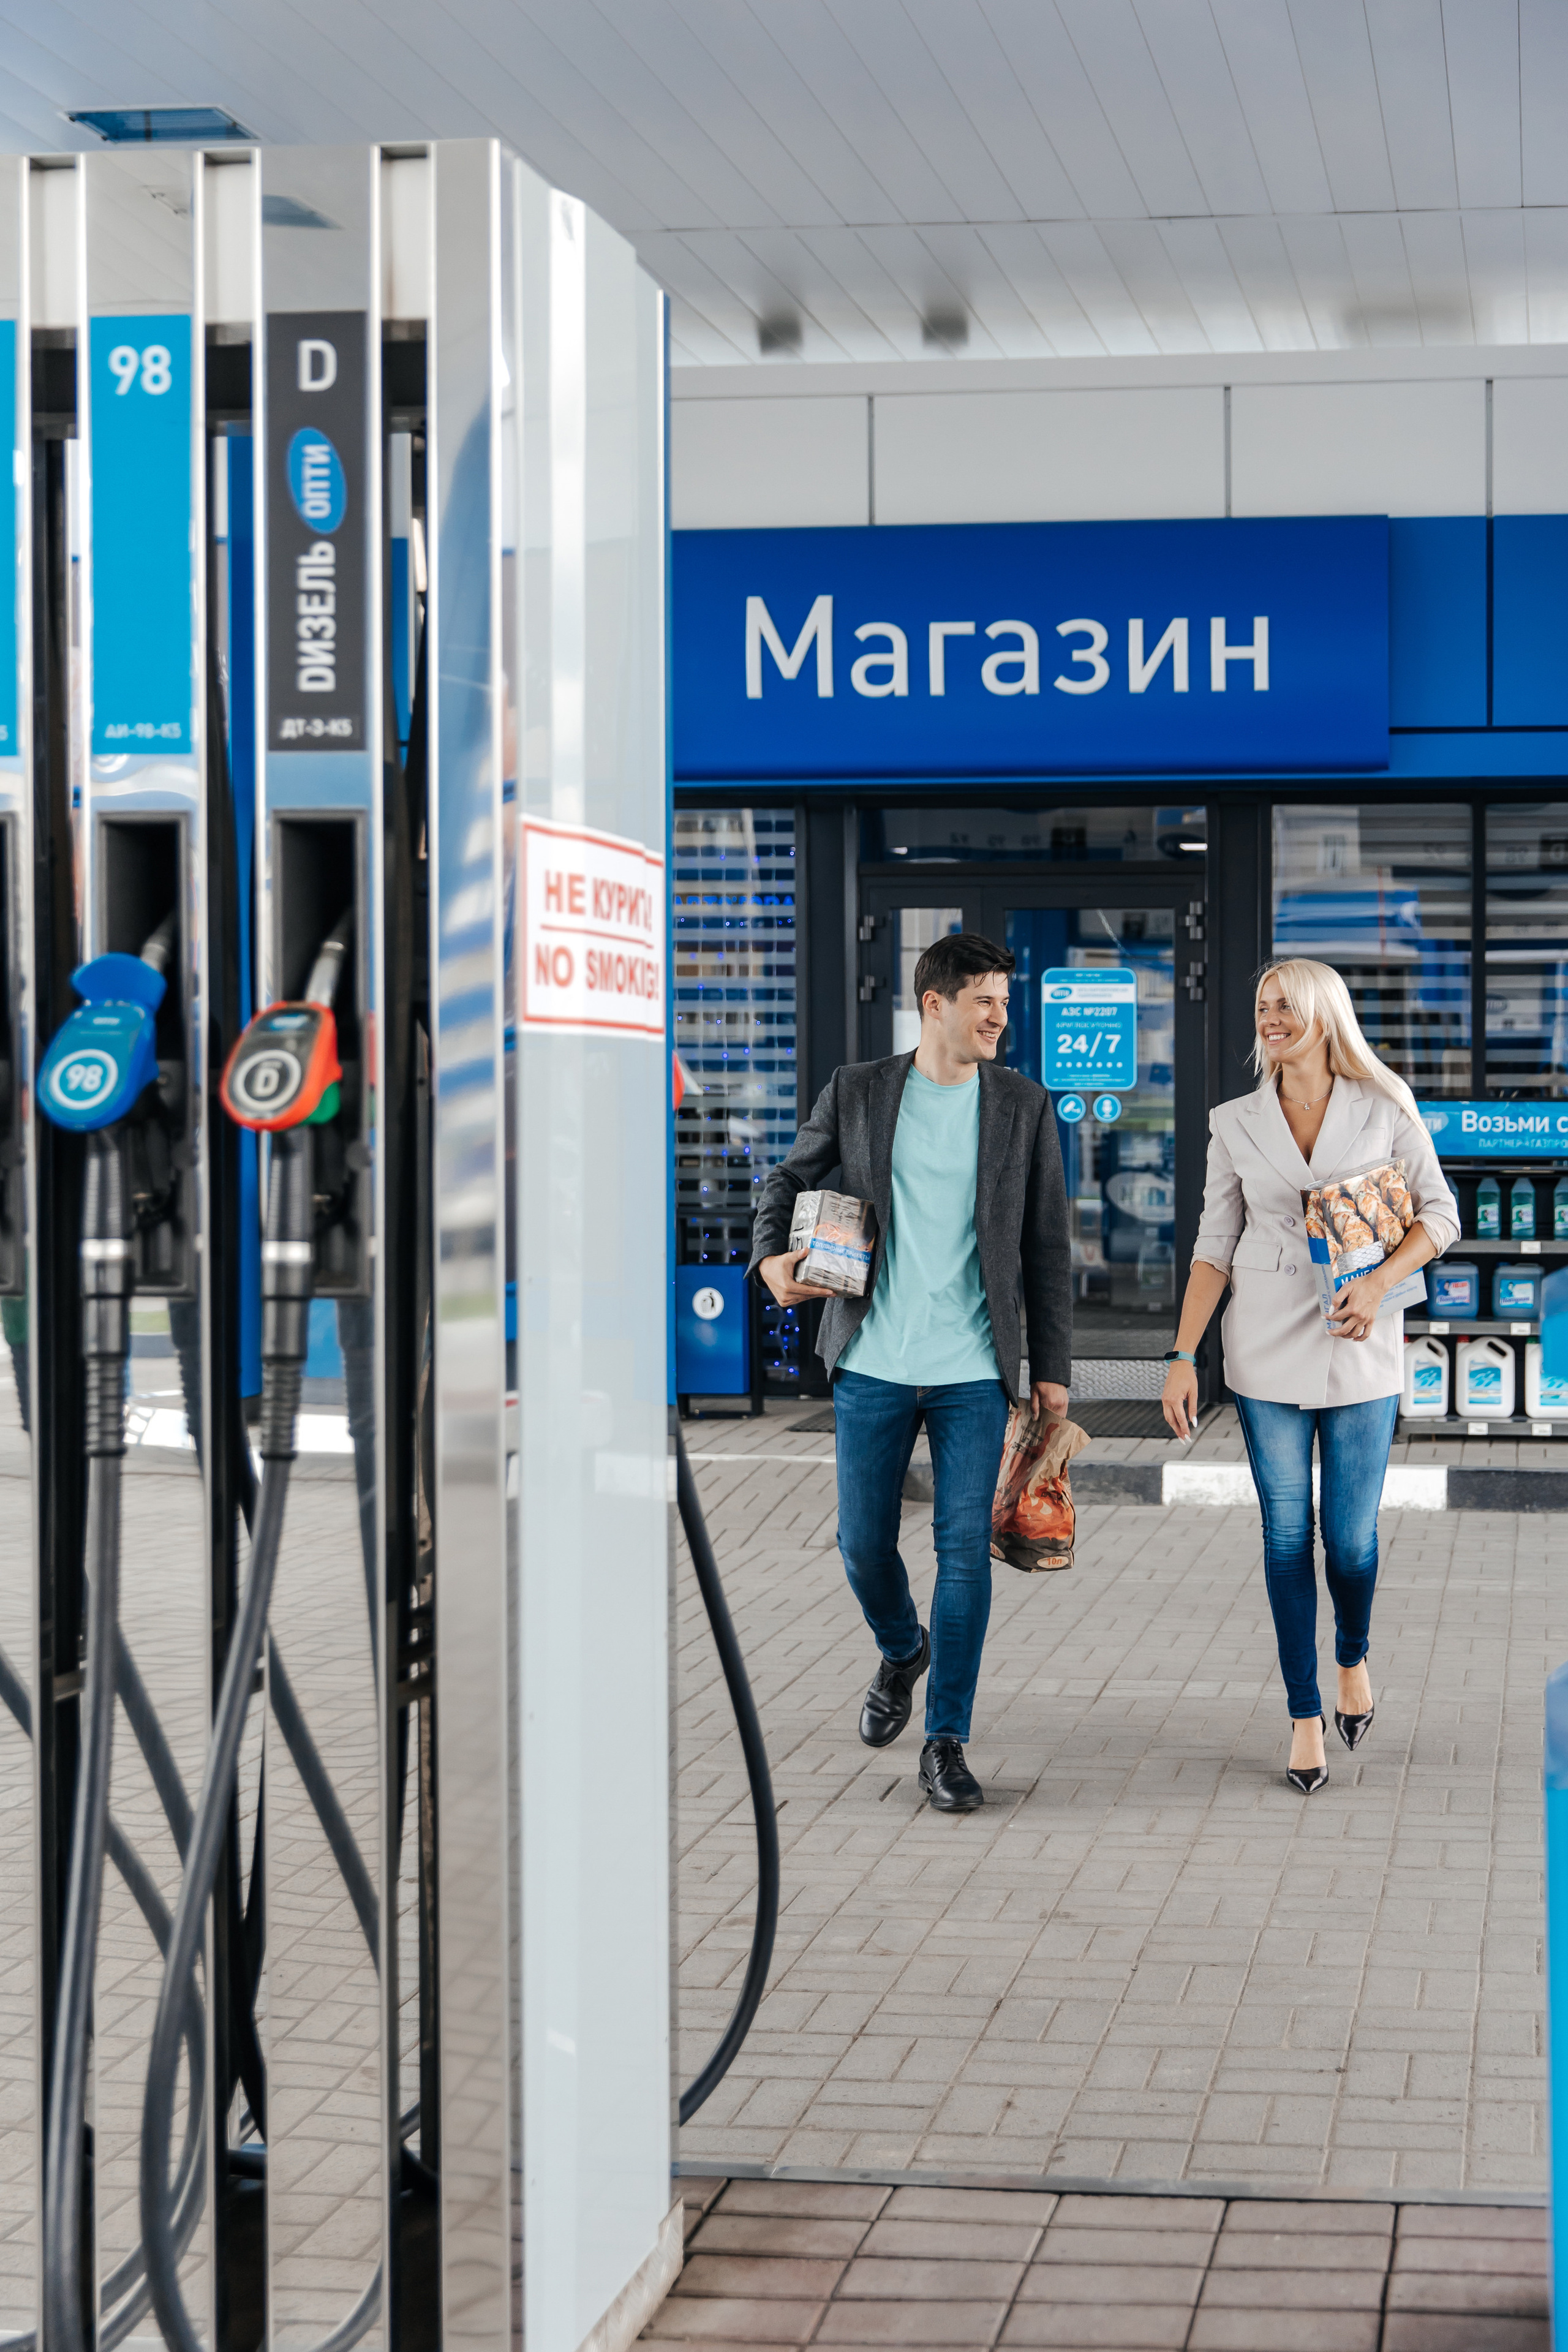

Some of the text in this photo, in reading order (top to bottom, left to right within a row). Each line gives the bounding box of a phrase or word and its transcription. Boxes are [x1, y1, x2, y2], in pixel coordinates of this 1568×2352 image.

[108, 345, 172, 396] 98
[298, 339, 337, 392] D
[745, 595, 1270, 699] Магазин
[545, 870, 586, 915] НЕ
[535, 943, 574, 987] NO
[1057, 1031, 1121, 1058] 24/7
[66, 1063, 104, 1093] 98
[1461, 1110, 1550, 1133] Возьми
